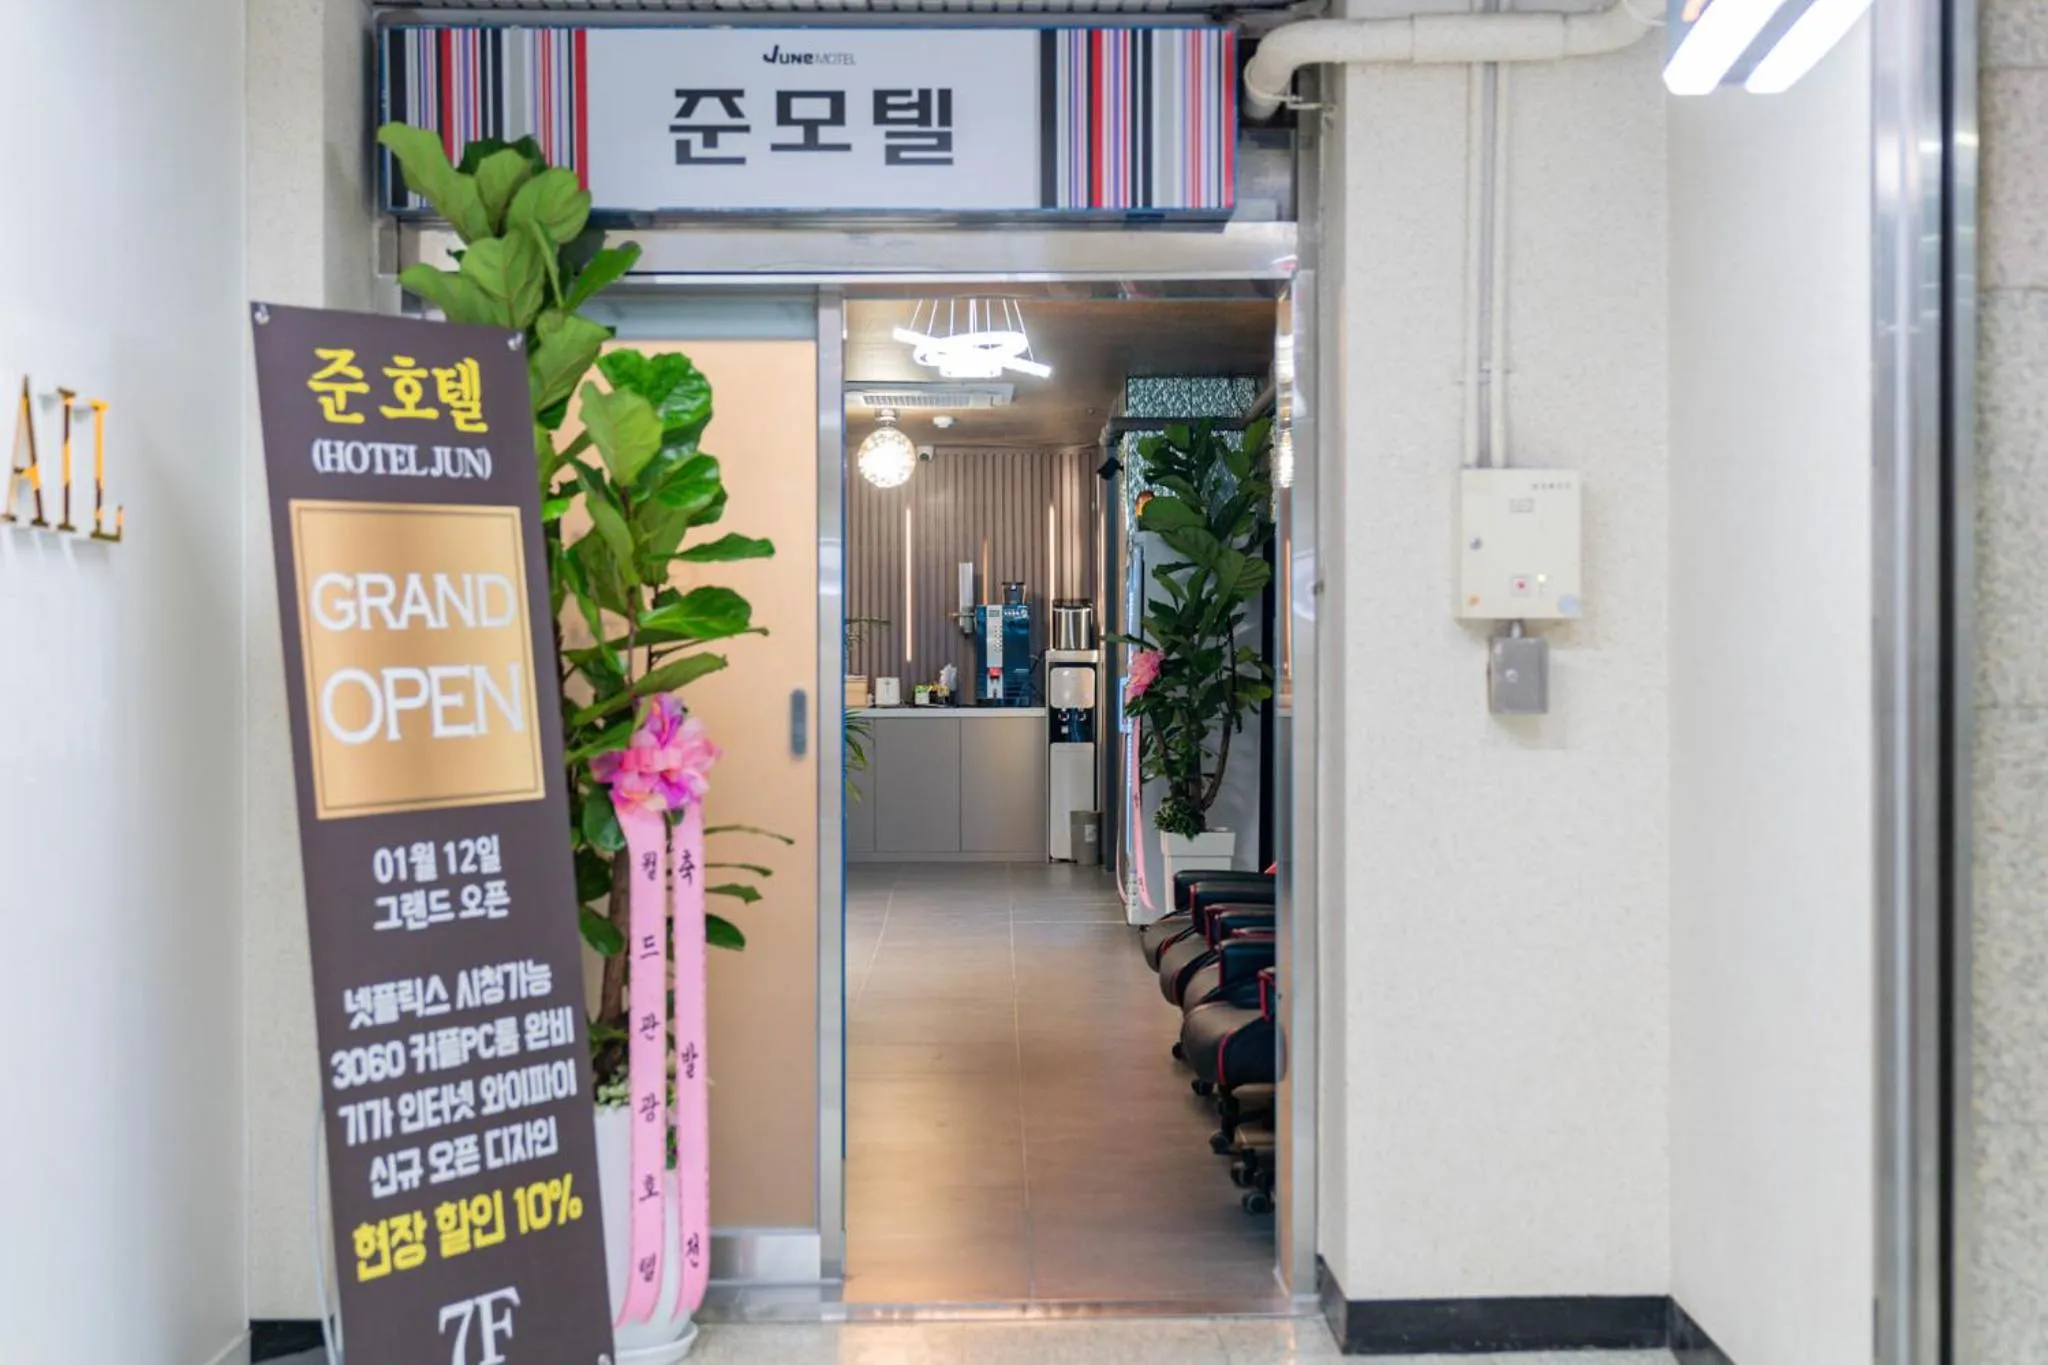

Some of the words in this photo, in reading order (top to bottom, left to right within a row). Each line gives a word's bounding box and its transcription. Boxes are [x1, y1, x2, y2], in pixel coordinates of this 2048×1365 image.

[669, 88, 953, 165] 준모텔
[306, 347, 371, 425] 준
[379, 355, 489, 433] 호텔
[311, 438, 428, 477] (HOTEL
[429, 445, 493, 481] JUN)
[310, 571, 516, 632] GRAND
[322, 660, 525, 745] OPEN
[373, 846, 438, 884] 01월
[443, 834, 502, 875] 12일
[373, 888, 455, 931] 그랜드
[459, 879, 511, 919] 오픈
[343, 974, 451, 1030] 넷플릭스
[330, 1039, 406, 1091] 3060
[408, 1016, 520, 1074] 커플PC룸
[524, 1005, 576, 1052] 완비
[337, 1096, 394, 1147] 기가
[397, 1079, 476, 1135] 인터넷
[479, 1058, 577, 1117] 와이파이
[370, 1147, 424, 1199] 신규
[427, 1133, 481, 1184] 오픈
[484, 1115, 559, 1170] 디자인
[352, 1209, 428, 1282] 현장
[434, 1189, 507, 1259] 할인
[513, 1172, 584, 1236] 10%
[438, 1285, 521, 1365] 7F
